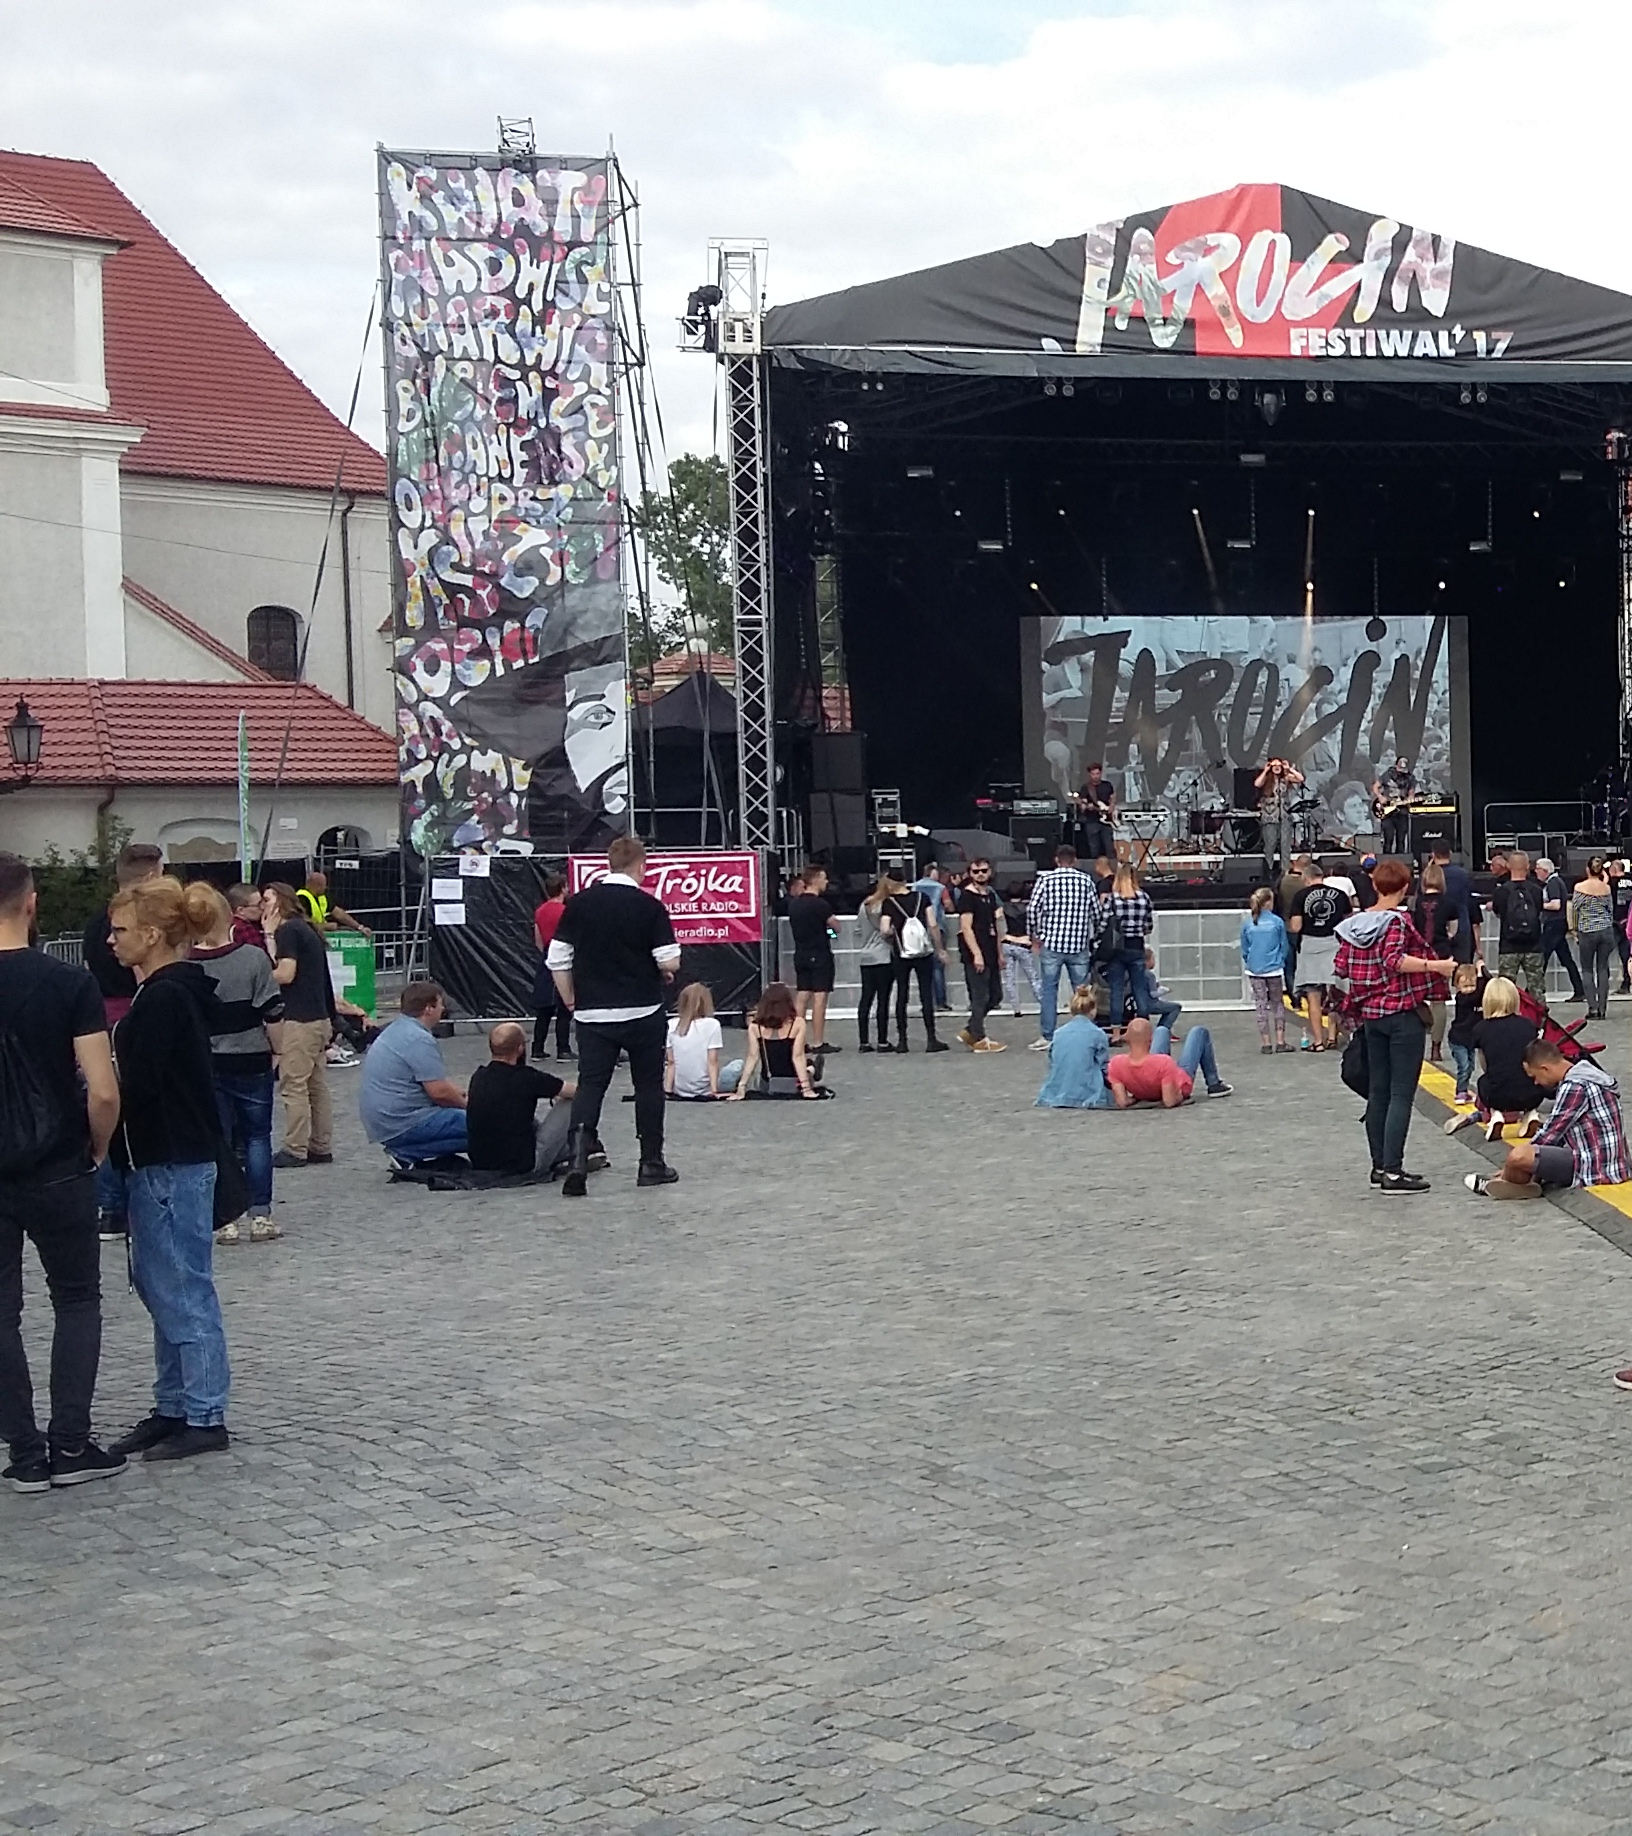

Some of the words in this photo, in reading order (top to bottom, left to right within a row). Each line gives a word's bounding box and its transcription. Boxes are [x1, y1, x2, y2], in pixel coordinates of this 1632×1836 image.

[1042, 217, 1457, 353] JAROCIN
[1290, 327, 1456, 357] FESTIWAL
[1044, 615, 1447, 800] JAROCIN
[645, 864, 744, 901] Trójka
[701, 901, 739, 912] RADIO
